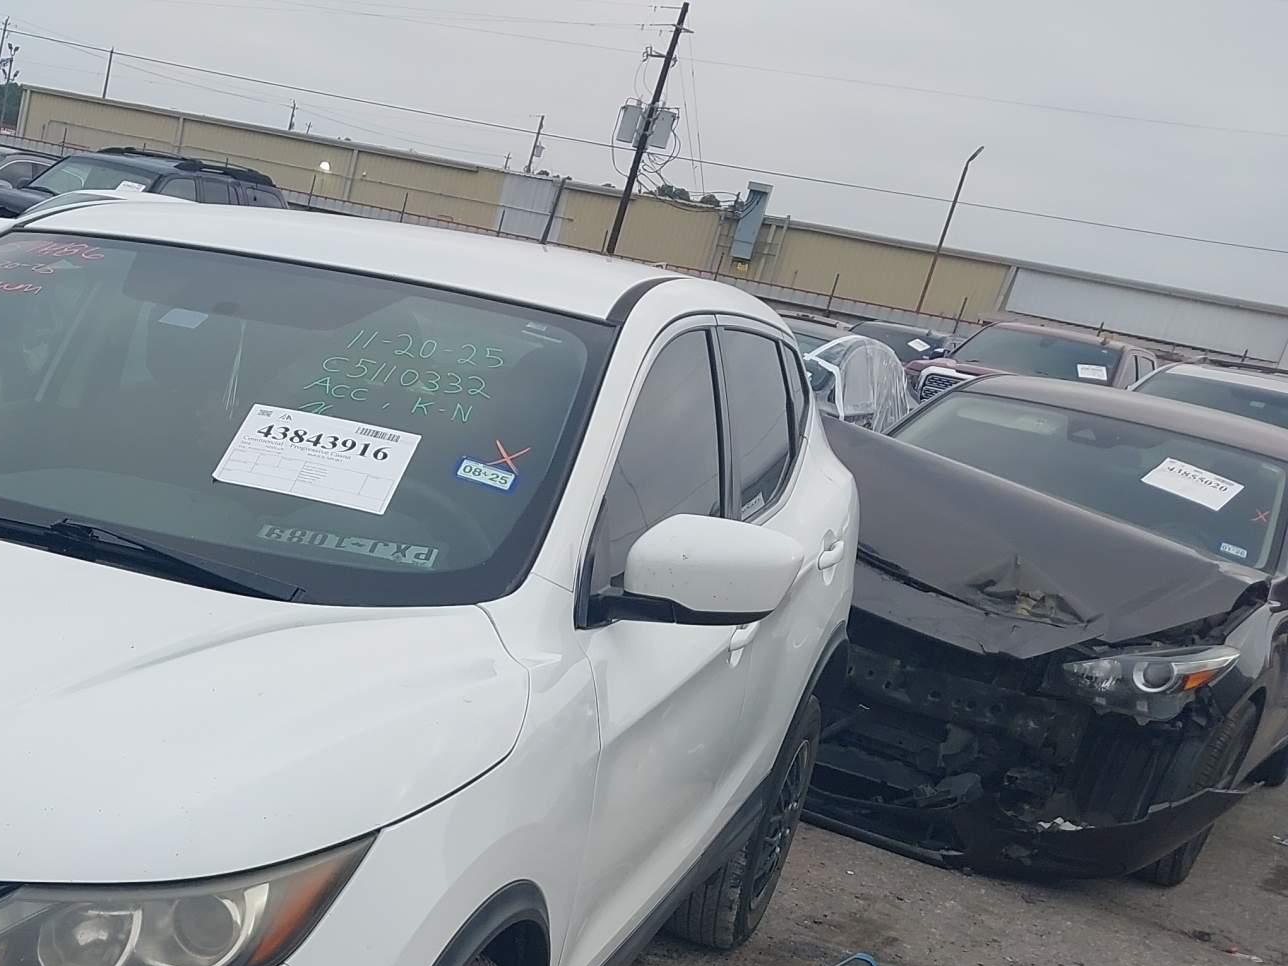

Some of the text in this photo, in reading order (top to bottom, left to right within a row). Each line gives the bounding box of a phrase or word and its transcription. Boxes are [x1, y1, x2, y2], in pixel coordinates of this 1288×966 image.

[346, 329, 505, 368] 11-20-25
[322, 356, 491, 399] C5110332
[257, 423, 393, 461] 43843916
